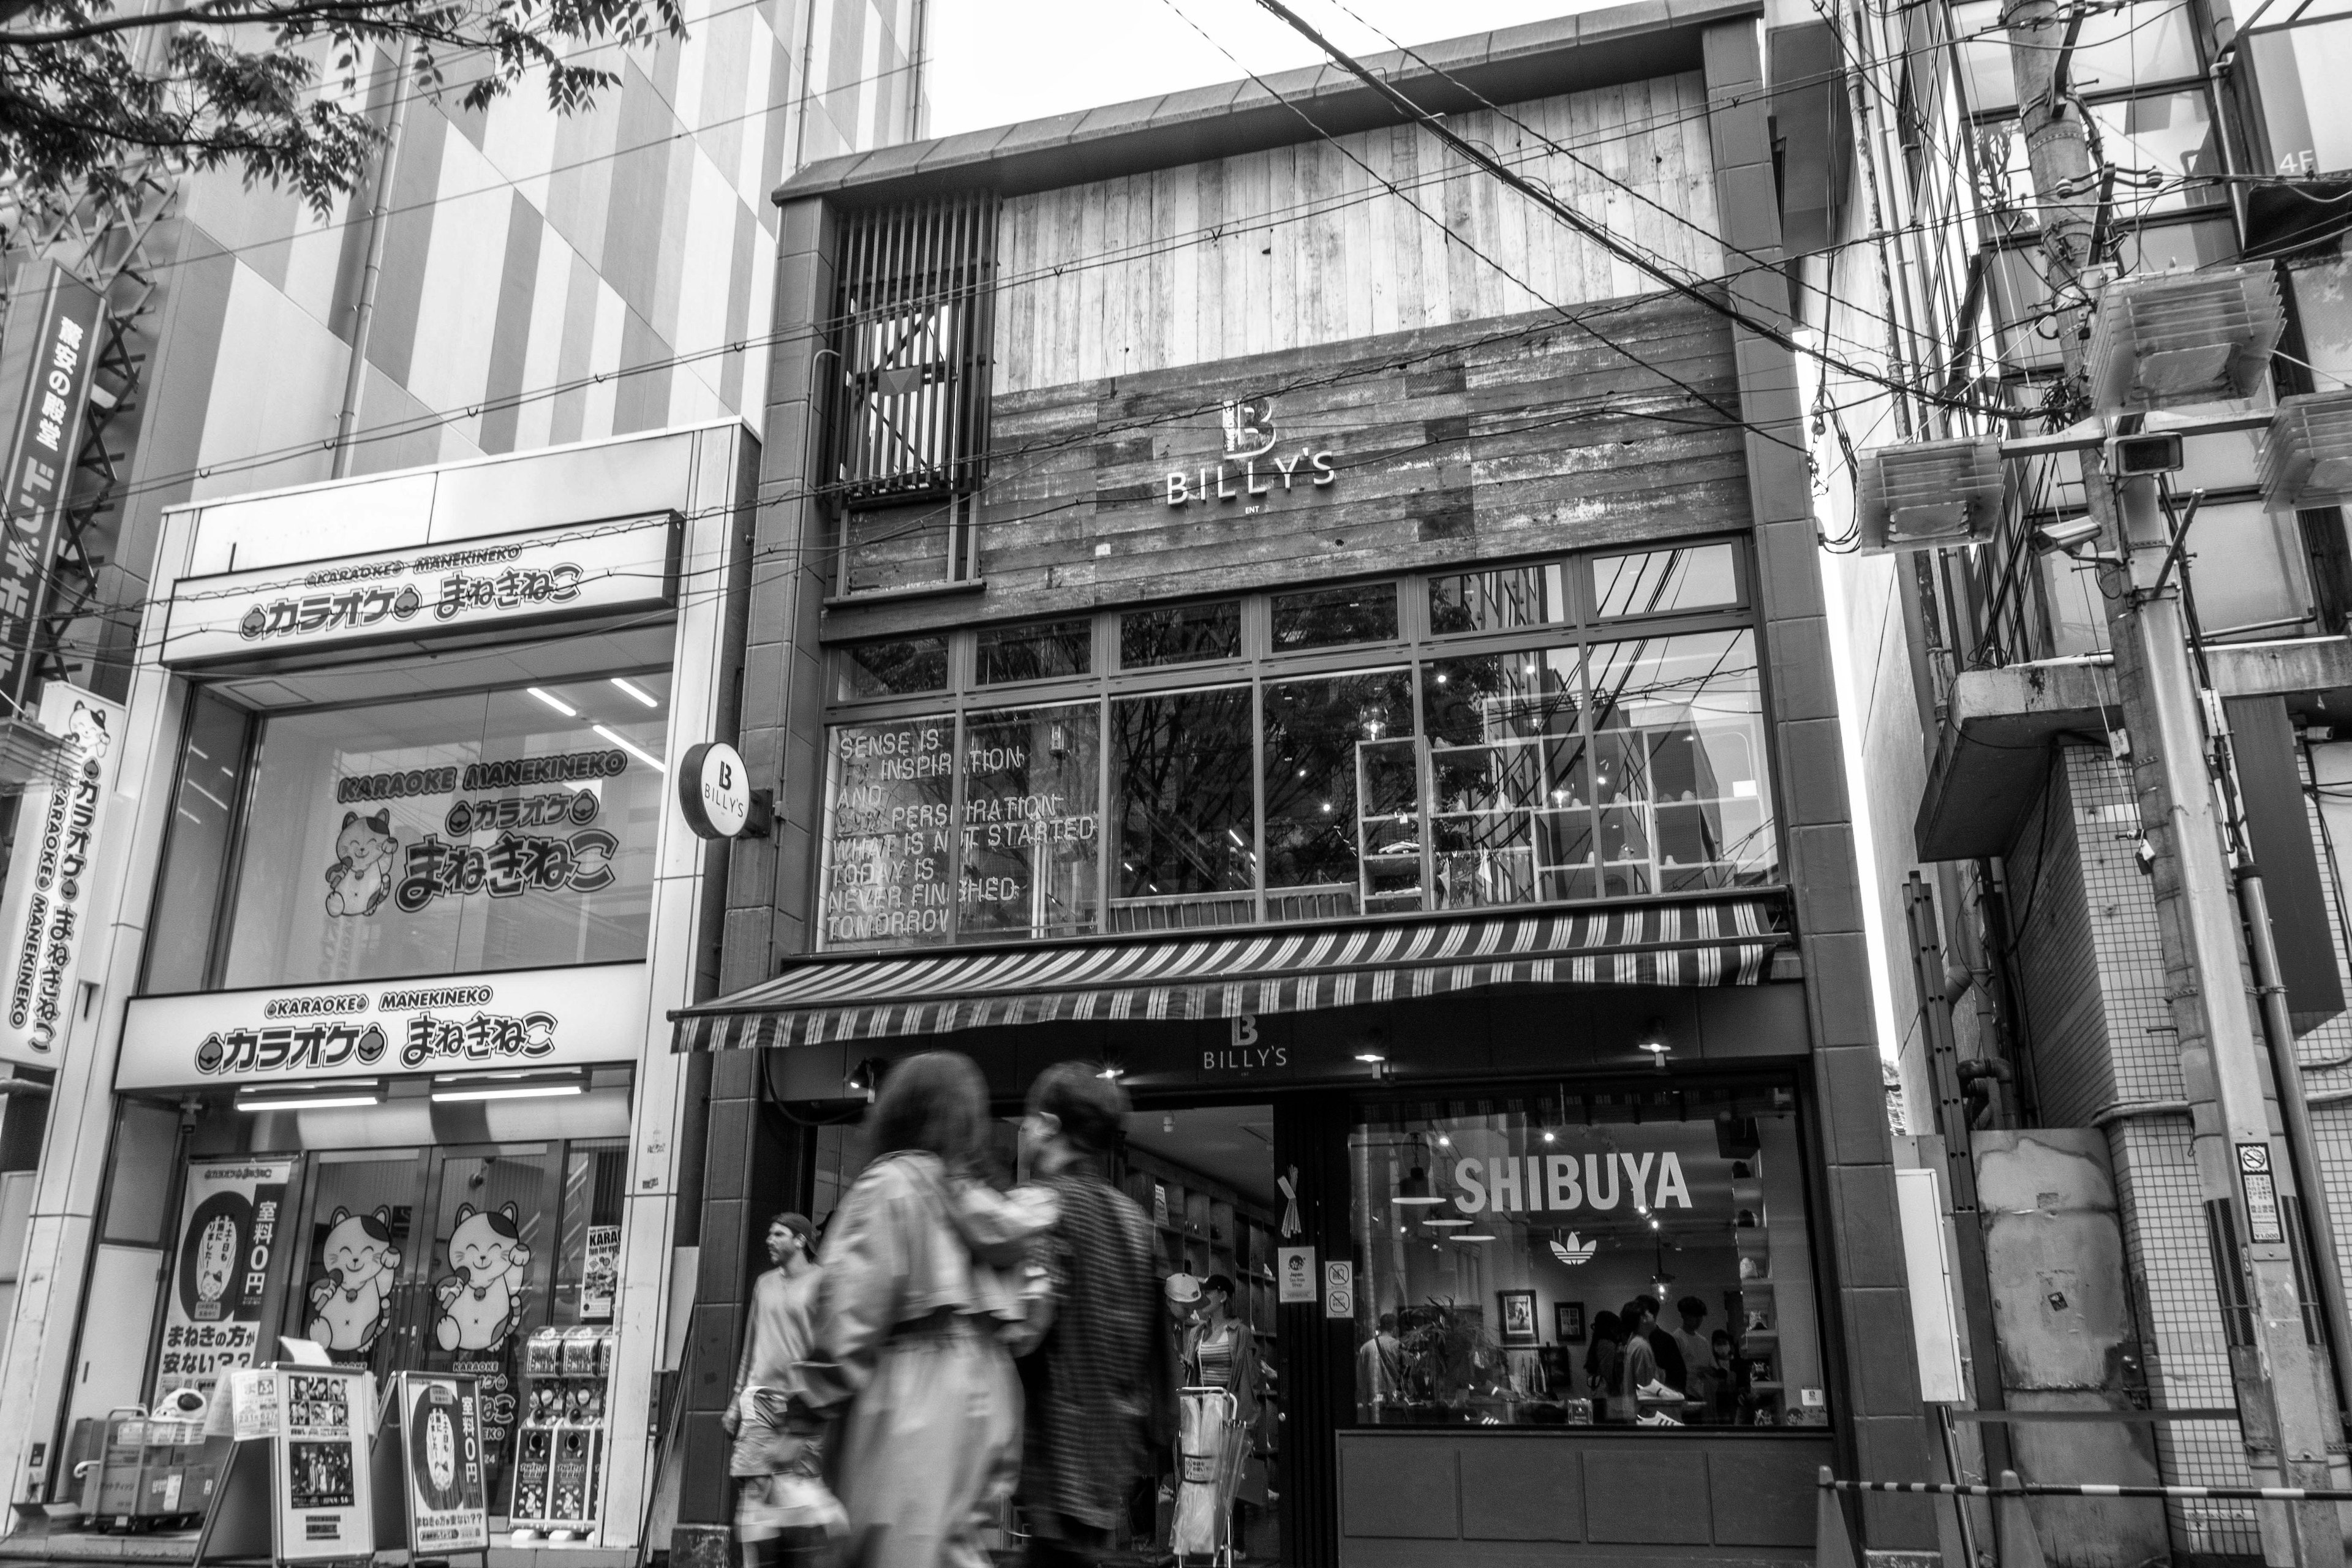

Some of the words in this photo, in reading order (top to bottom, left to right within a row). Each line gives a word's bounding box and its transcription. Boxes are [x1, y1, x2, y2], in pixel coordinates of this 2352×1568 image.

[2279, 149, 2314, 173] 4F
[36, 316, 83, 451] 驚安の殿堂
[1167, 447, 1335, 505] BILLY'S
[1245, 505, 1260, 514] ENT
[317, 562, 393, 586] KARAOKE
[414, 545, 522, 573] MANEKINEKO
[263, 587, 397, 638] カラオケ
[434, 562, 583, 620] まねきねこ
[840, 732, 911, 758] SENSE
[920, 729, 939, 752] IS
[338, 767, 458, 803] KARAOKE
[463, 750, 628, 790] MANEKINEKO
[881, 746, 1022, 781] INSPIRTION
[472, 793, 573, 832] カラオケ
[704, 783, 744, 818] BILLY'S
[836, 785, 882, 809] AND
[892, 793, 1055, 829] PERSIRATION
[62, 781, 101, 878] カラオケ
[834, 835, 895, 861] WHAT
[905, 832, 924, 856] IS
[934, 826, 979, 853] NT
[988, 816, 1094, 846] STARTED
[396, 829, 619, 913] まねきねこ
[831, 859, 906, 887] TODAY
[915, 858, 934, 881] IS
[828, 886, 902, 913] NEVER
[10, 894, 49, 1028] MANEKINEKO
[29, 905, 77, 1054] まねきねこ
[277, 995, 356, 1016] KARAOKE
[379, 986, 492, 1011] MANEKINEKO
[220, 1022, 364, 1074] カラオケ
[401, 1011, 558, 1069] まねきねこ
[1204, 1046, 1287, 1069] BILLY'S
[1455, 1152, 1692, 1214] SHIBUYA
[167, 1325, 255, 1348] まねきの方が
[453, 1362, 499, 1372] KARAOKE
